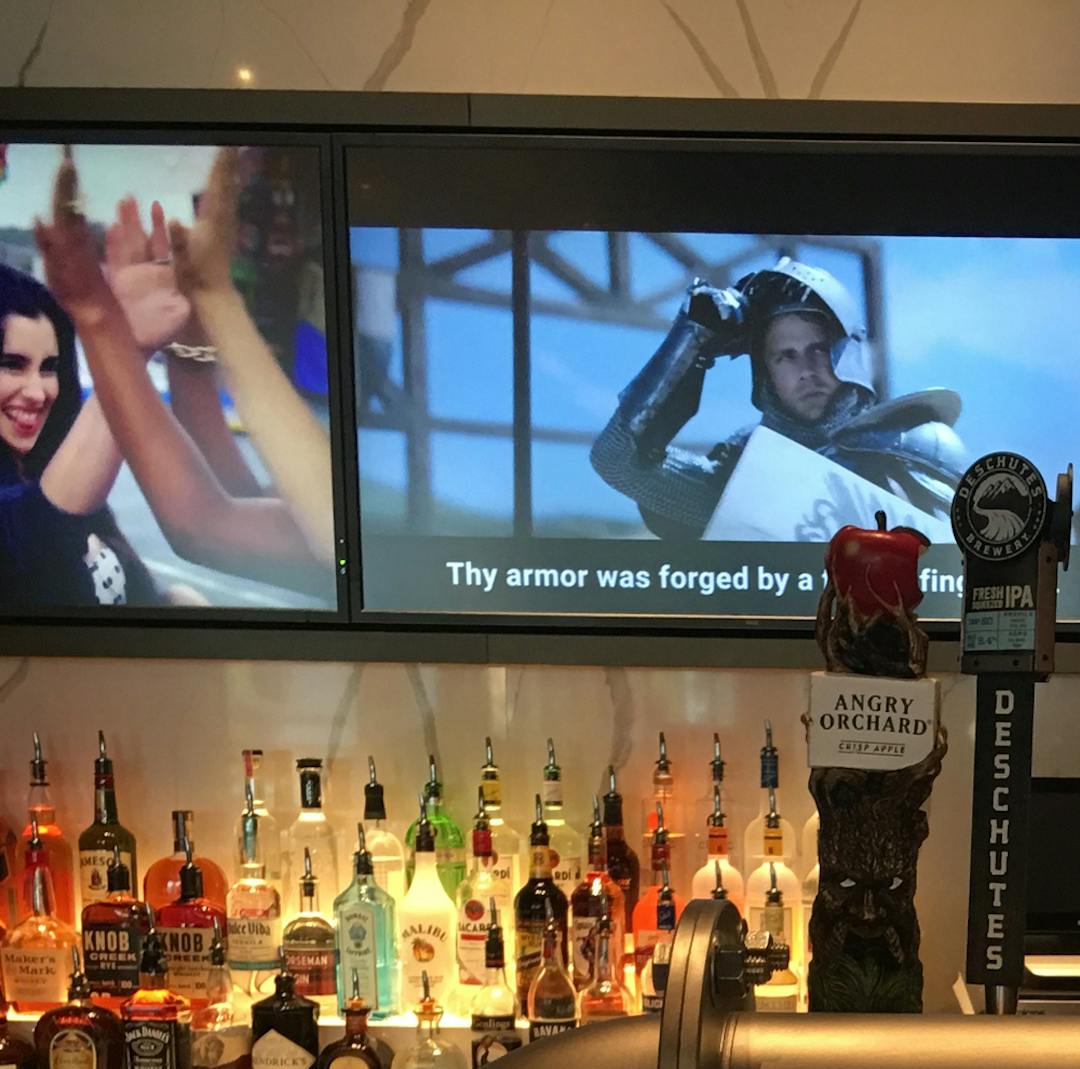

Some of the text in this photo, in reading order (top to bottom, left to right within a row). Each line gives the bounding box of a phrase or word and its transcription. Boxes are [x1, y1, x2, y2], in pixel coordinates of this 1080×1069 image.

[960, 456, 1043, 500] DESCHUTES
[966, 528, 1031, 558] BREWERY
[446, 562, 499, 592] Thy
[505, 566, 589, 588] armor
[597, 569, 651, 589] was
[658, 565, 748, 596] forged
[757, 567, 790, 596] by
[798, 574, 814, 590] a
[972, 587, 1004, 601] FRESH
[1004, 584, 1035, 609] IPA
[834, 694, 914, 715] ANGRY
[820, 713, 928, 736] ORCHARD
[986, 690, 1015, 971] DESCHUTES
[84, 931, 130, 951] KNOB
[158, 932, 204, 953] KNOB
[4, 953, 57, 963] Maker's
[90, 952, 137, 962] CREEK
[286, 954, 328, 967] ORSEMAN
[19, 965, 57, 975] Mark
